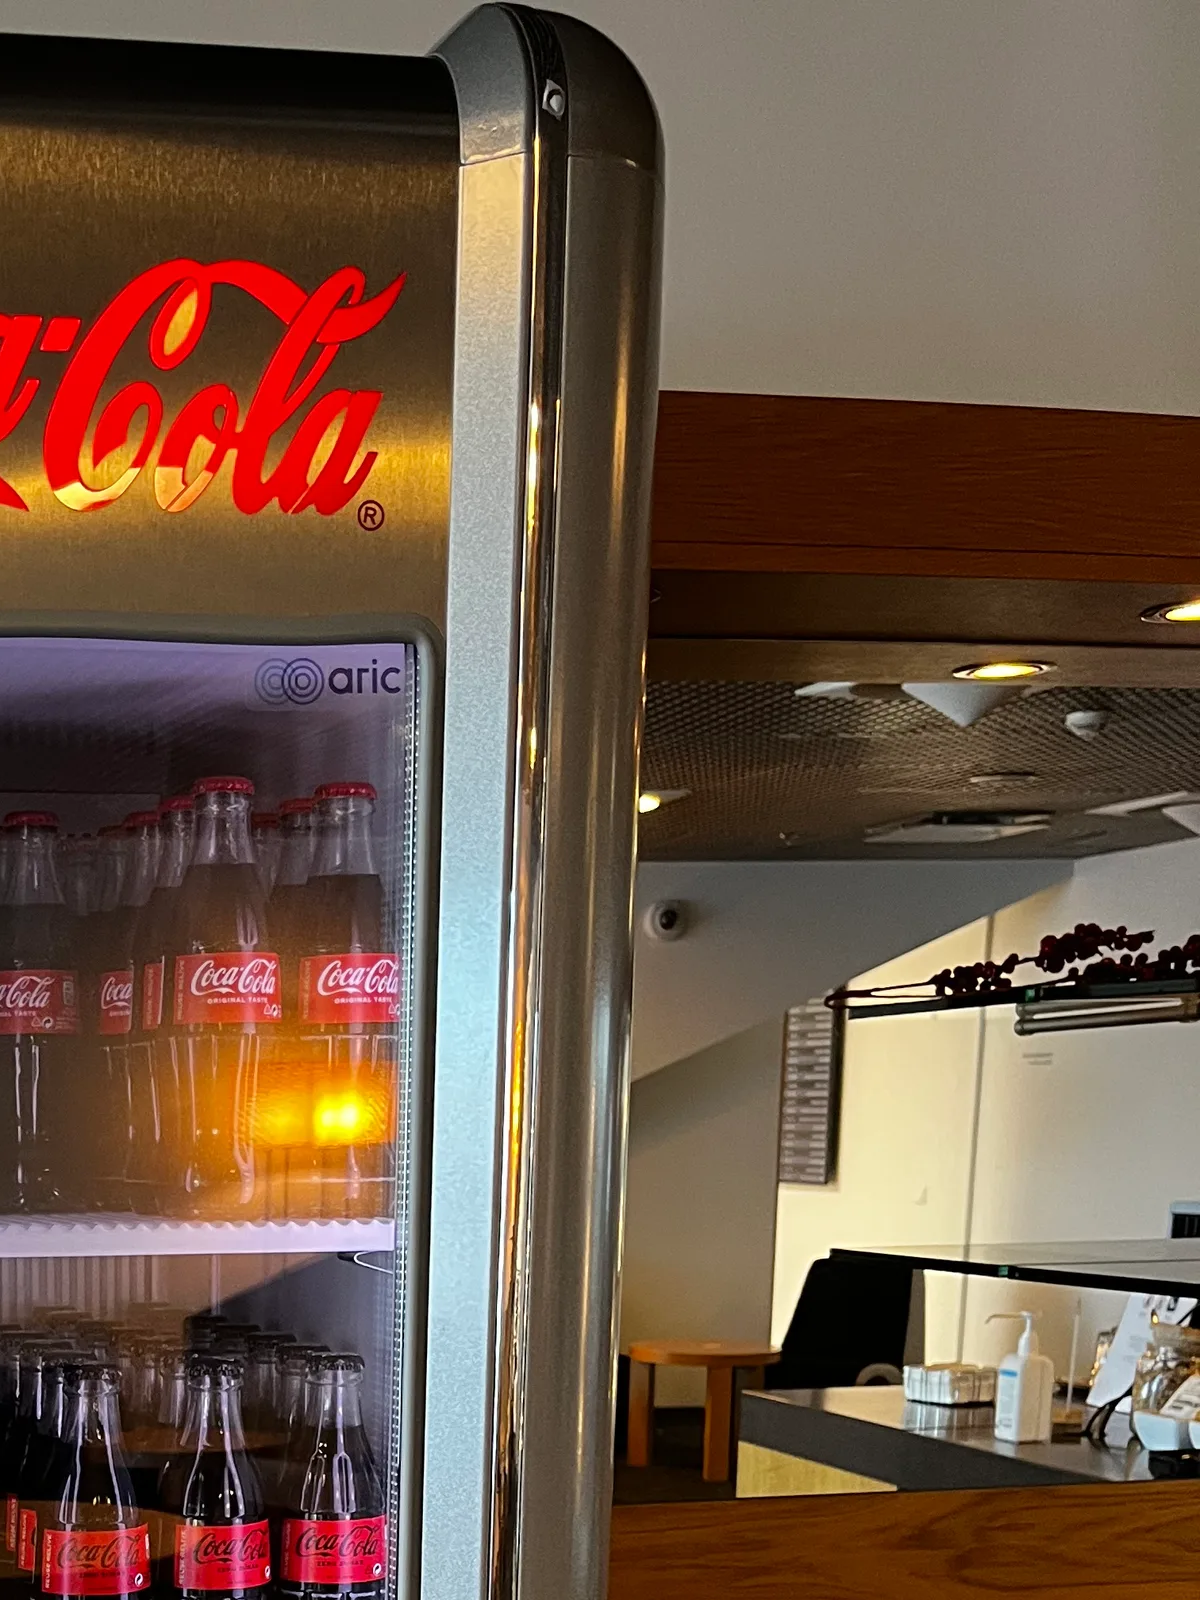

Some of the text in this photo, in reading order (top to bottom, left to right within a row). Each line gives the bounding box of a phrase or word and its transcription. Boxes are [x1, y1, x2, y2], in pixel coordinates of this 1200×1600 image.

[328, 659, 401, 694] aric
[190, 959, 276, 995] Coca-Cola
[317, 959, 399, 995] Coca-Cola
[57, 1533, 140, 1569] Coca-Cola
[295, 1525, 379, 1557] Coca-Cola
